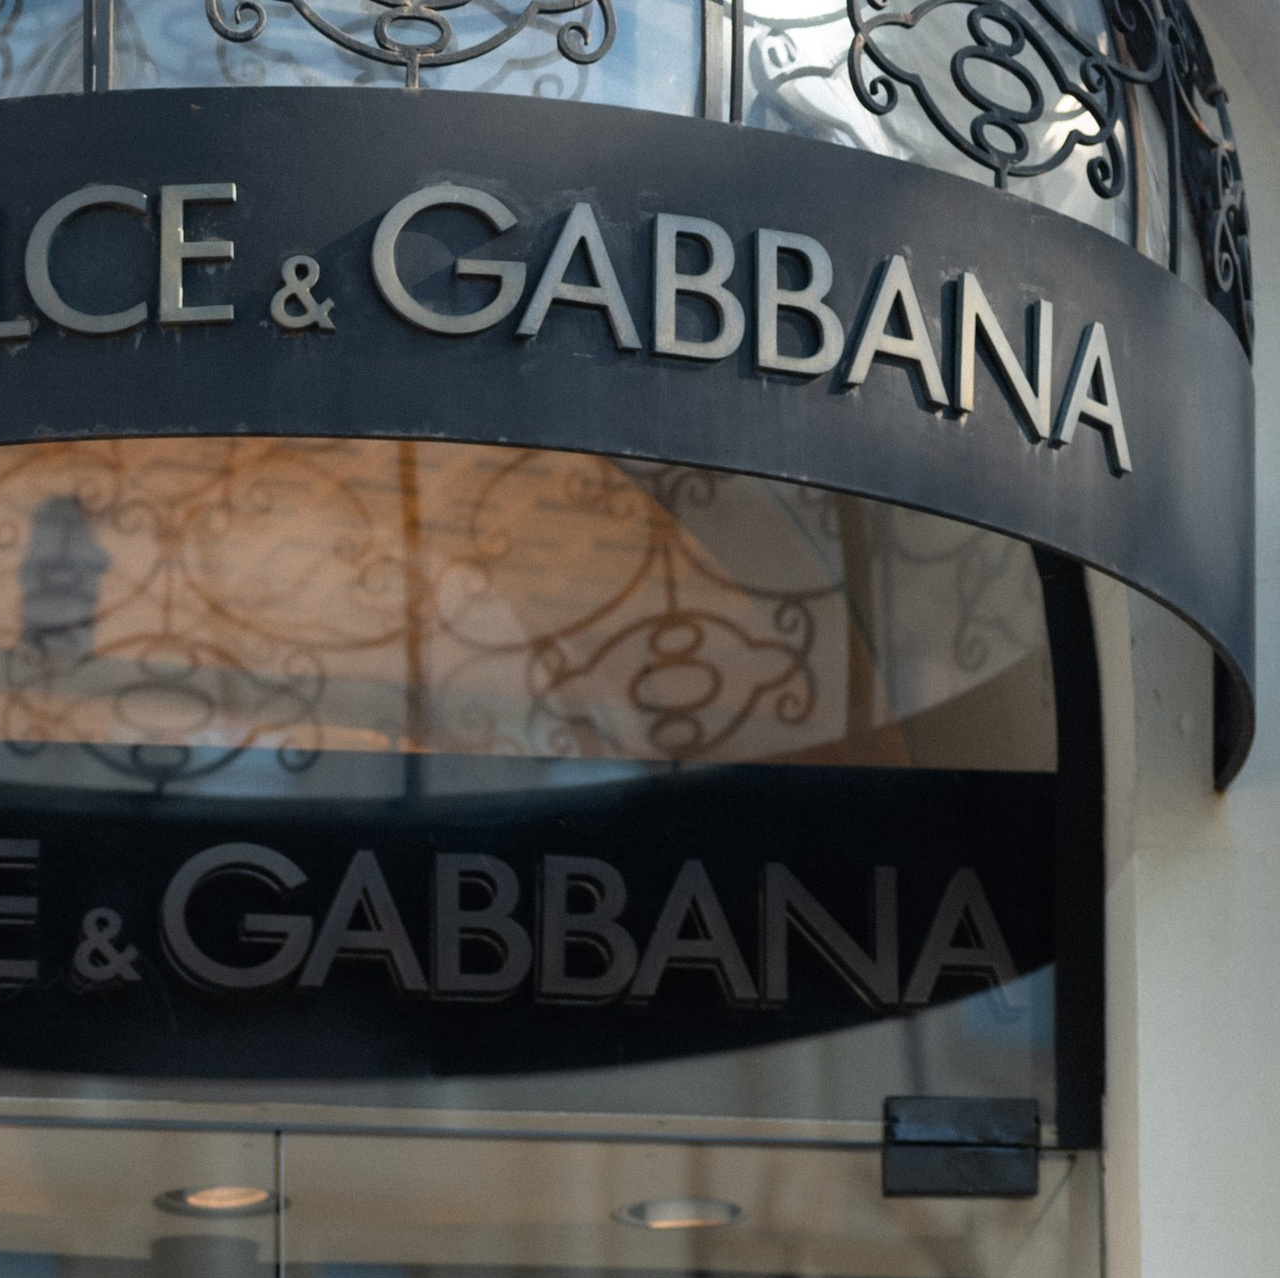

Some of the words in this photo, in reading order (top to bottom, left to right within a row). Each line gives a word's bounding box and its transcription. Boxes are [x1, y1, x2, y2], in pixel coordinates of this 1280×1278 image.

[268, 253, 337, 332] &
[371, 183, 1133, 475] GABBANA
[71, 906, 142, 984] &
[158, 842, 1028, 1015] GABBANA
